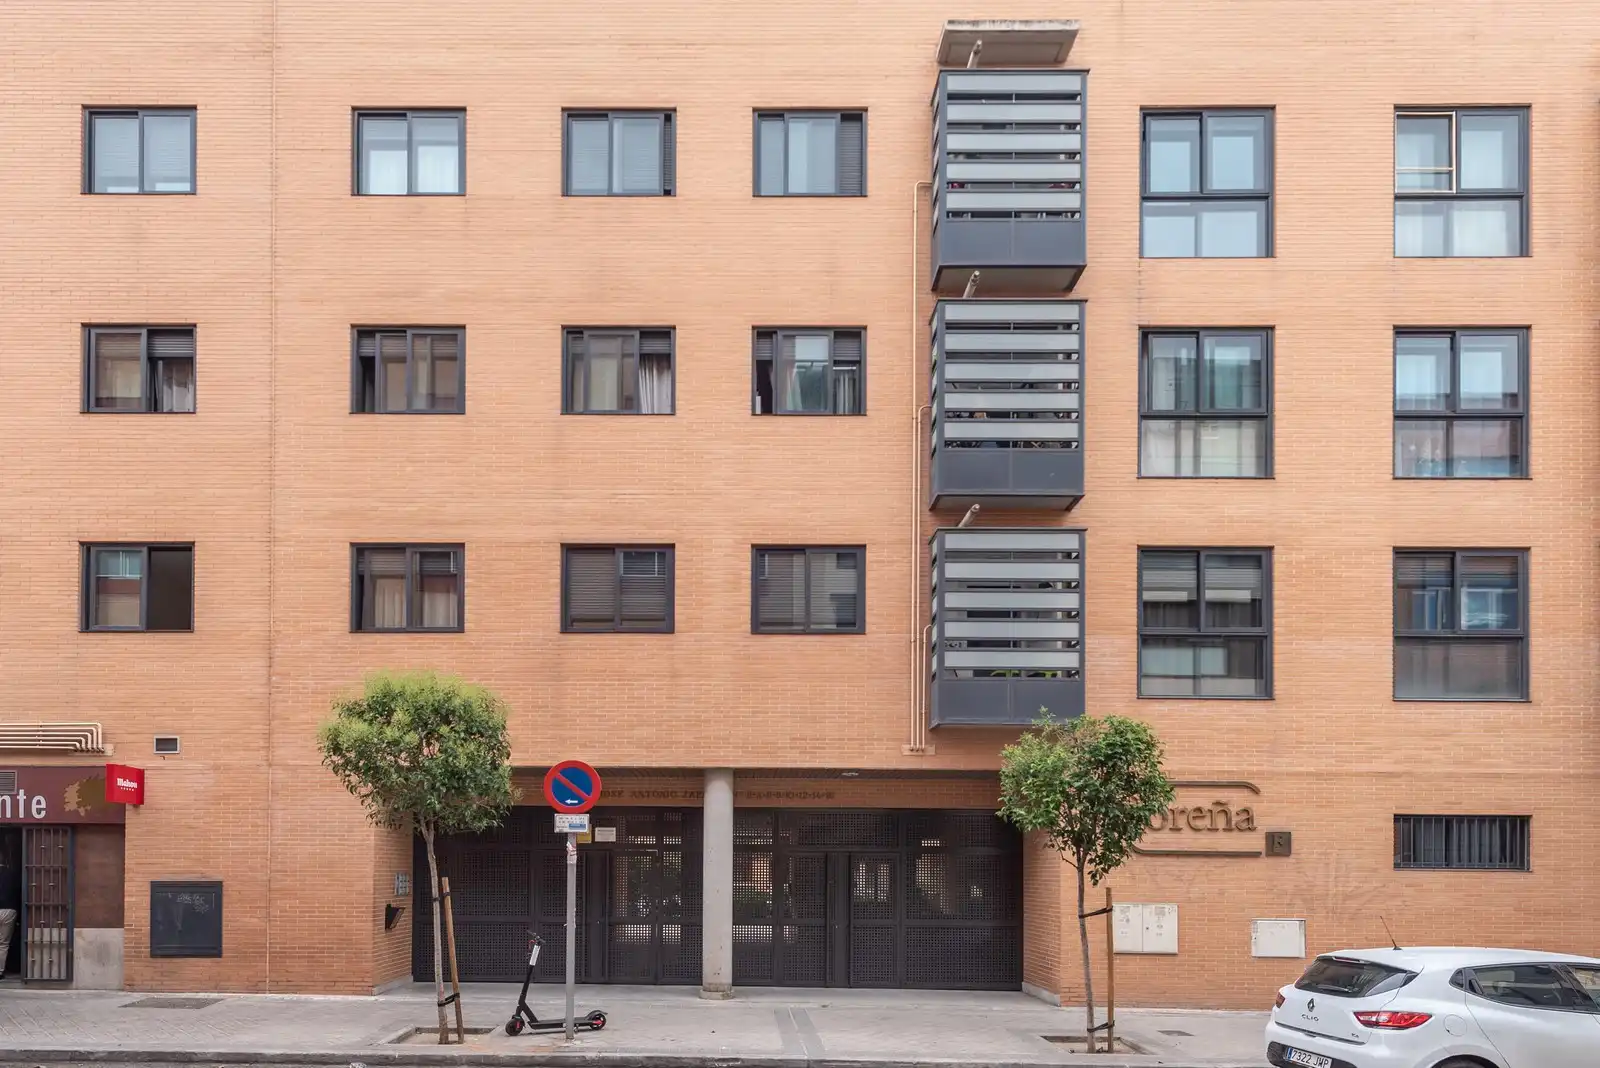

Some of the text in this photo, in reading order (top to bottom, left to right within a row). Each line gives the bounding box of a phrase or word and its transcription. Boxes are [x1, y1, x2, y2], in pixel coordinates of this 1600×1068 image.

[116, 777, 138, 789] Mahou
[1301, 1013, 1319, 1022] CLIO
[1291, 1050, 1312, 1064] 7322
